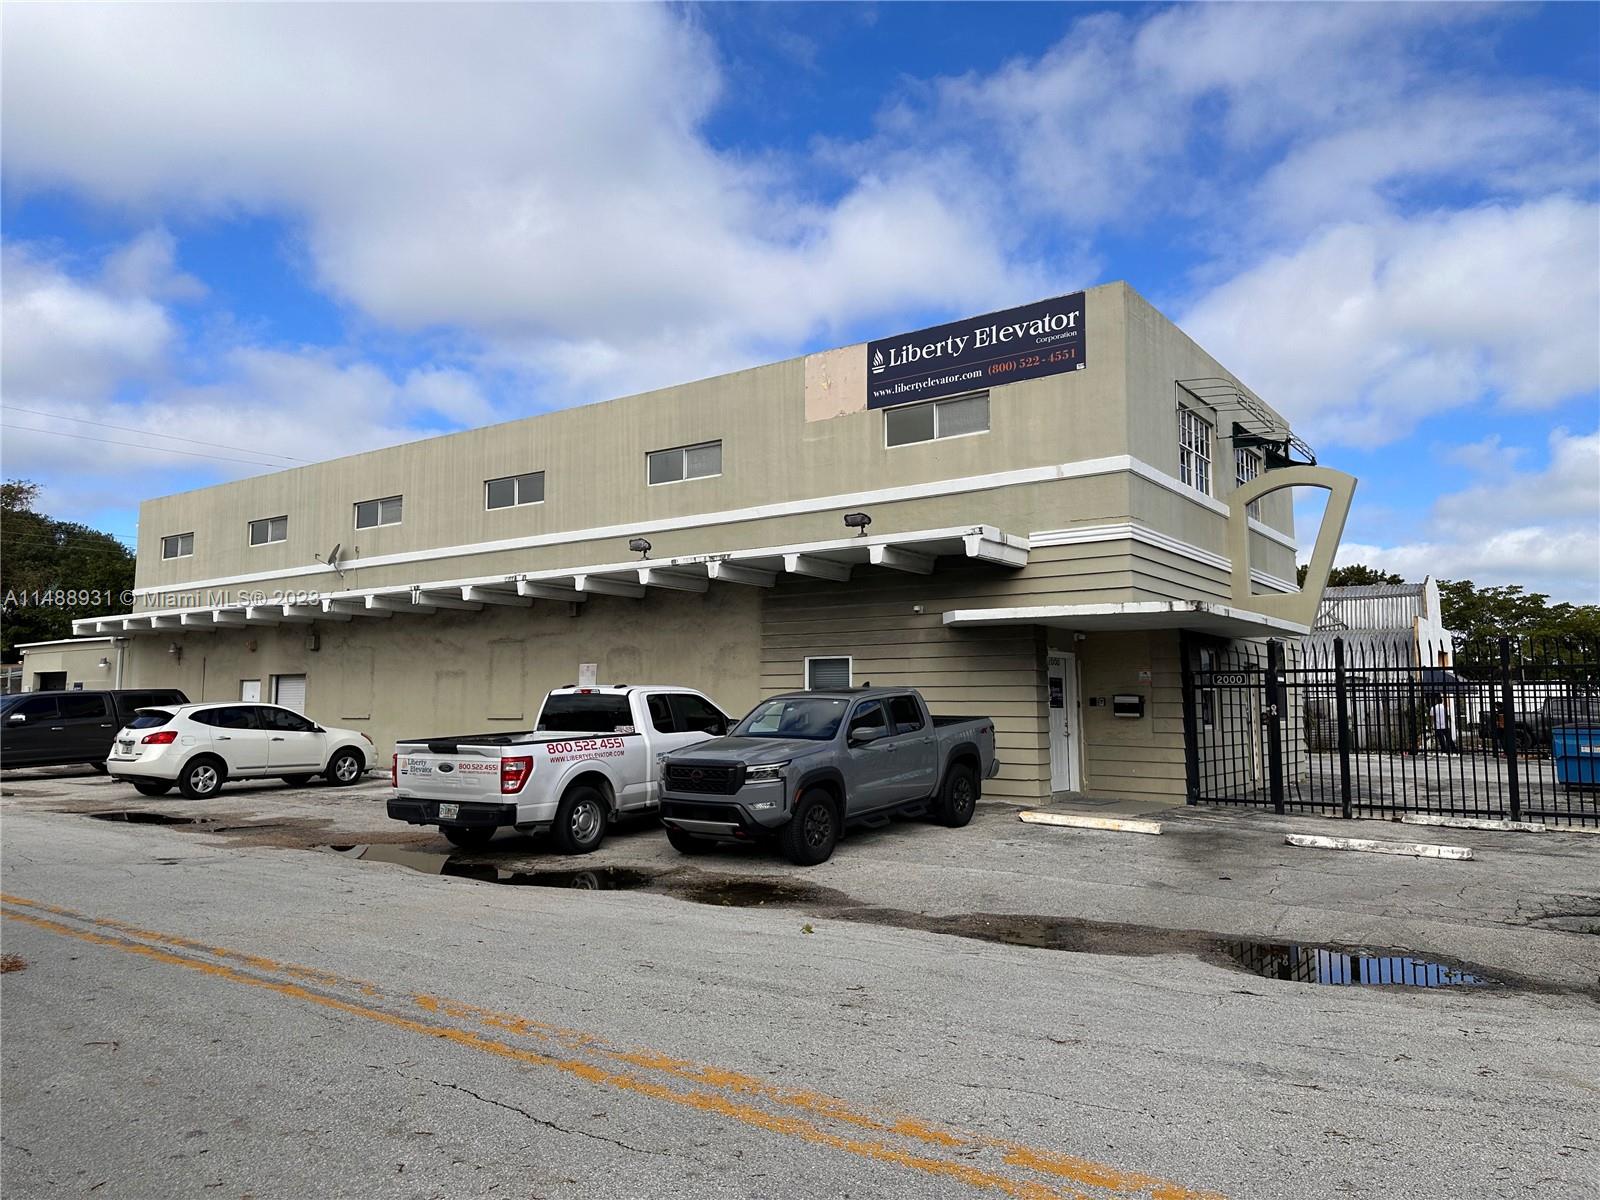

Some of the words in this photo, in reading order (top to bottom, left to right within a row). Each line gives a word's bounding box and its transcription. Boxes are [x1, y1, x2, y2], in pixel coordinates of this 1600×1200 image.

[889, 335, 969, 368] Liberty
[973, 310, 1080, 349] Elevator
[1035, 330, 1078, 344] Corporation
[873, 369, 982, 398] www.libertyelevator.com
[987, 360, 1017, 377] (800)
[1216, 675, 1243, 684] 2000
[546, 737, 625, 754] 800.522.4551
[407, 758, 427, 767] Liberty
[550, 750, 625, 763] WWW.LIBERTYELEVATOR.COM
[410, 765, 432, 773] Elevator
